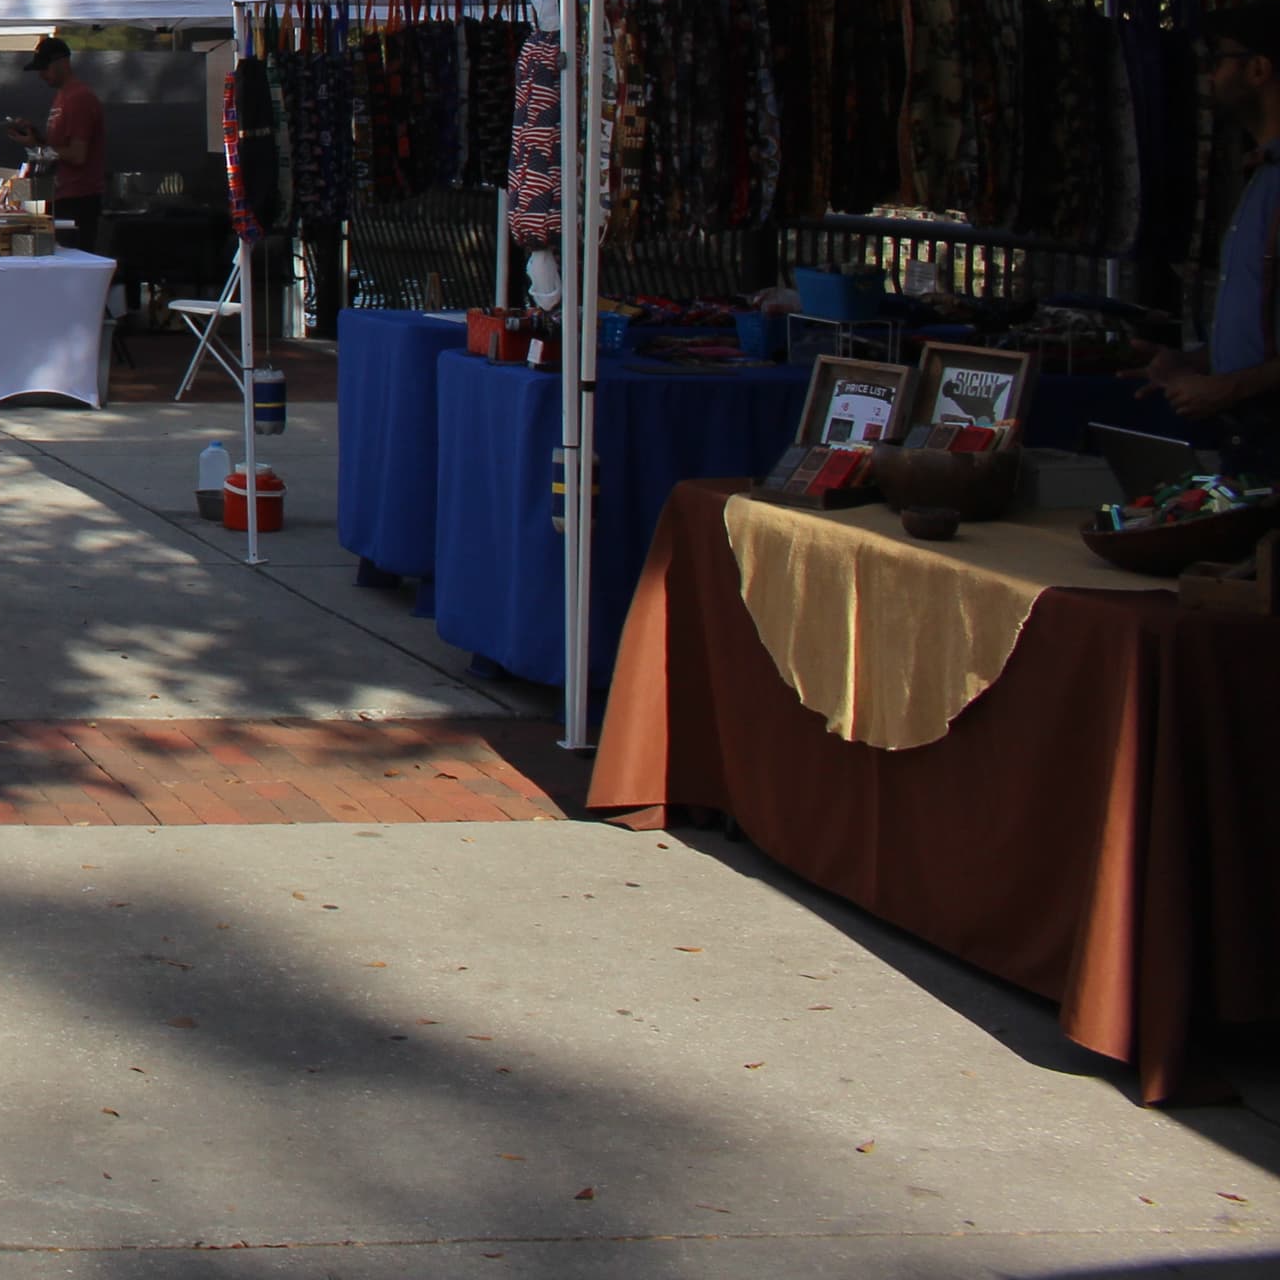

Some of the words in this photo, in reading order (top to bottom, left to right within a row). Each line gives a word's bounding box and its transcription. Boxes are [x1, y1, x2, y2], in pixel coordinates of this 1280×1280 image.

[845, 383, 868, 395] PRICE
[869, 386, 887, 397] LIST
[953, 371, 1000, 399] SICILY
